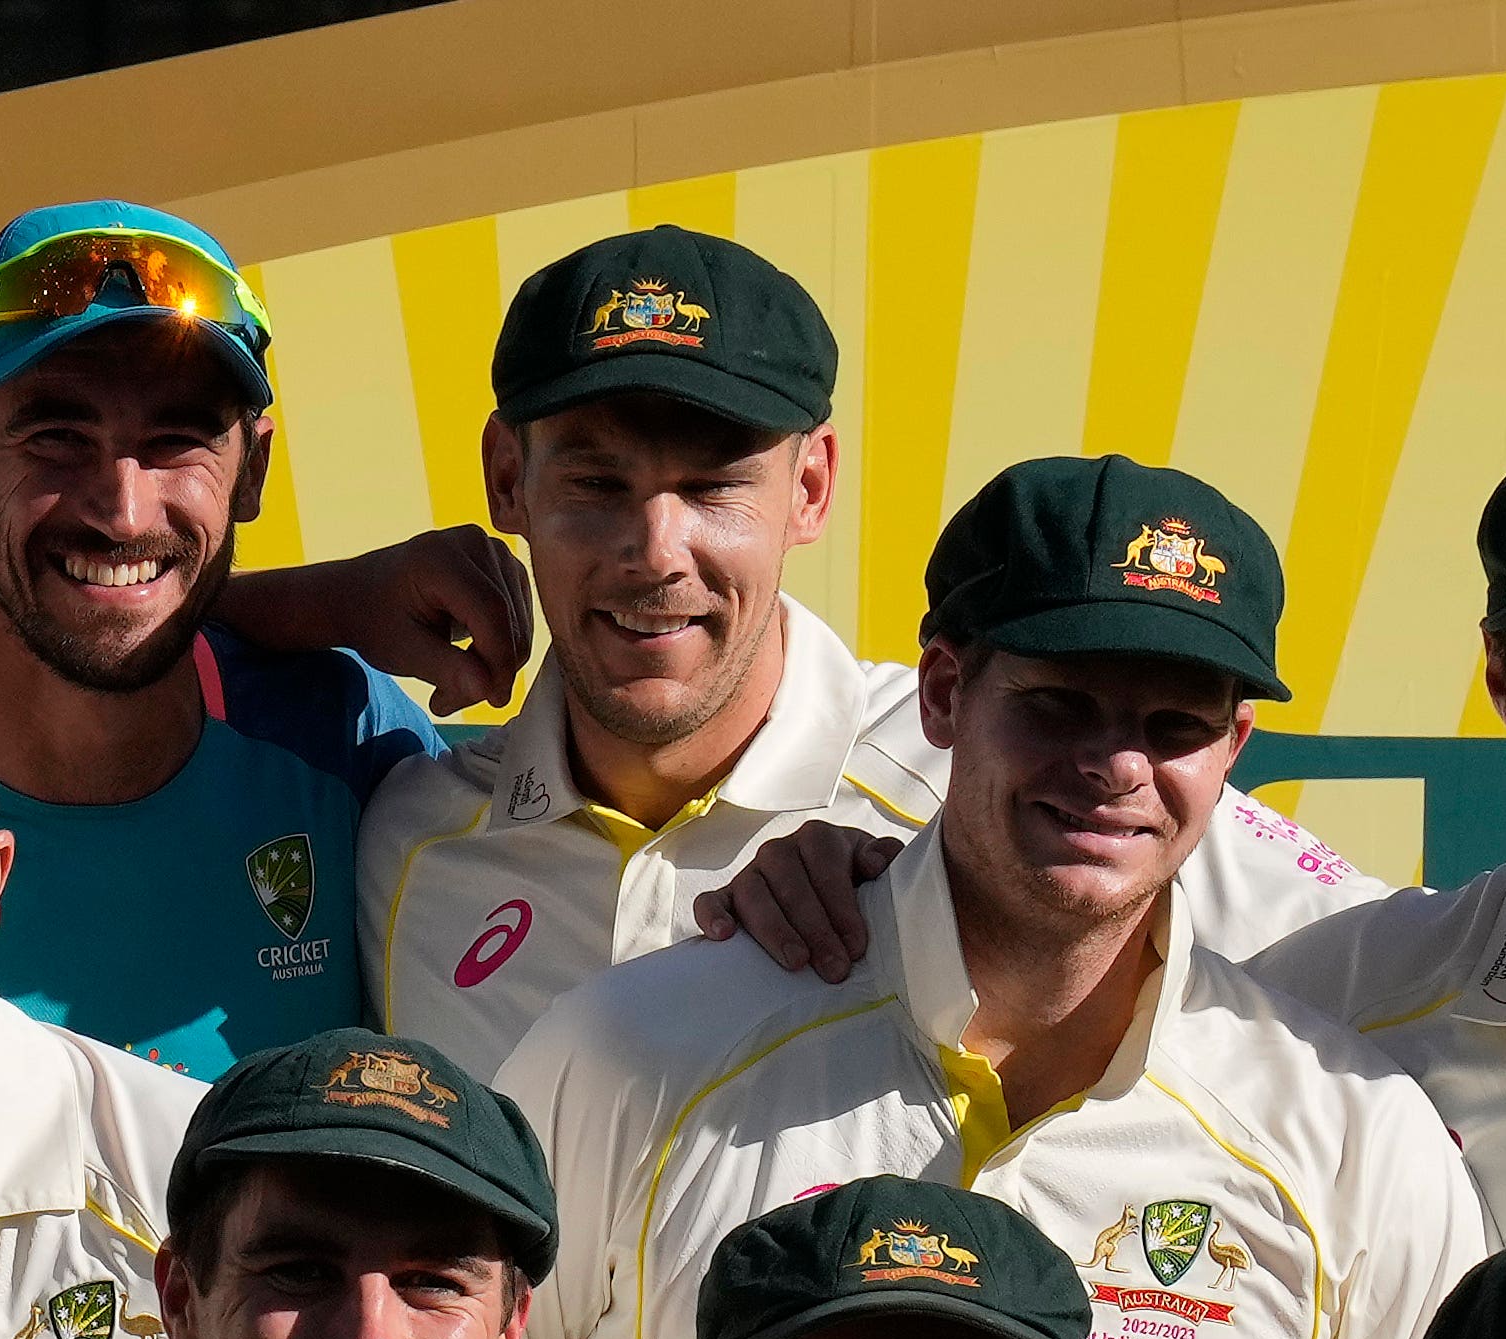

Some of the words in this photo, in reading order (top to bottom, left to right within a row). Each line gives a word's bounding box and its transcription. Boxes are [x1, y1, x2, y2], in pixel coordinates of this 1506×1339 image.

[1148, 575, 1203, 601] AUSTRALIA
[257, 938, 331, 968] CRICKET
[272, 964, 325, 981] AUSTRALIA
[1120, 1293, 1205, 1321] AUSTRALIA
